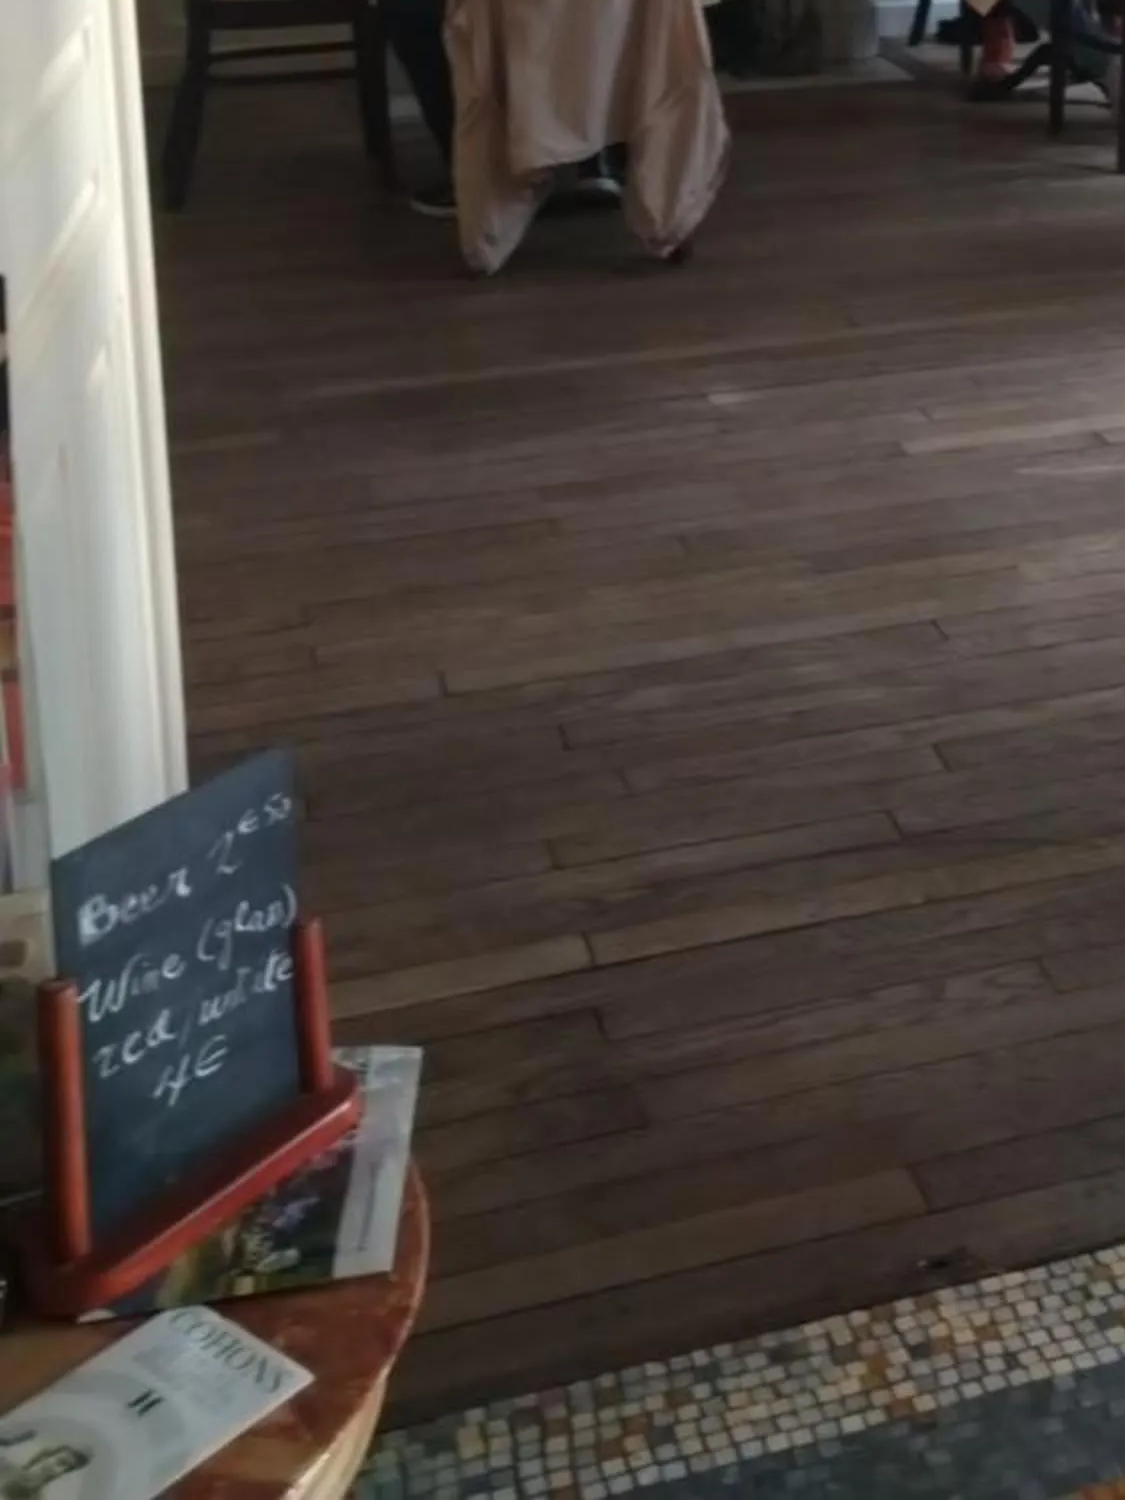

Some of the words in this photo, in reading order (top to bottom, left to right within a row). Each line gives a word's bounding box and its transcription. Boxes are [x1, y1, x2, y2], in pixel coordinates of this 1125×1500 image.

[78, 868, 192, 947] Beer
[77, 953, 187, 1022] Wine
[151, 1034, 230, 1106] 4€
